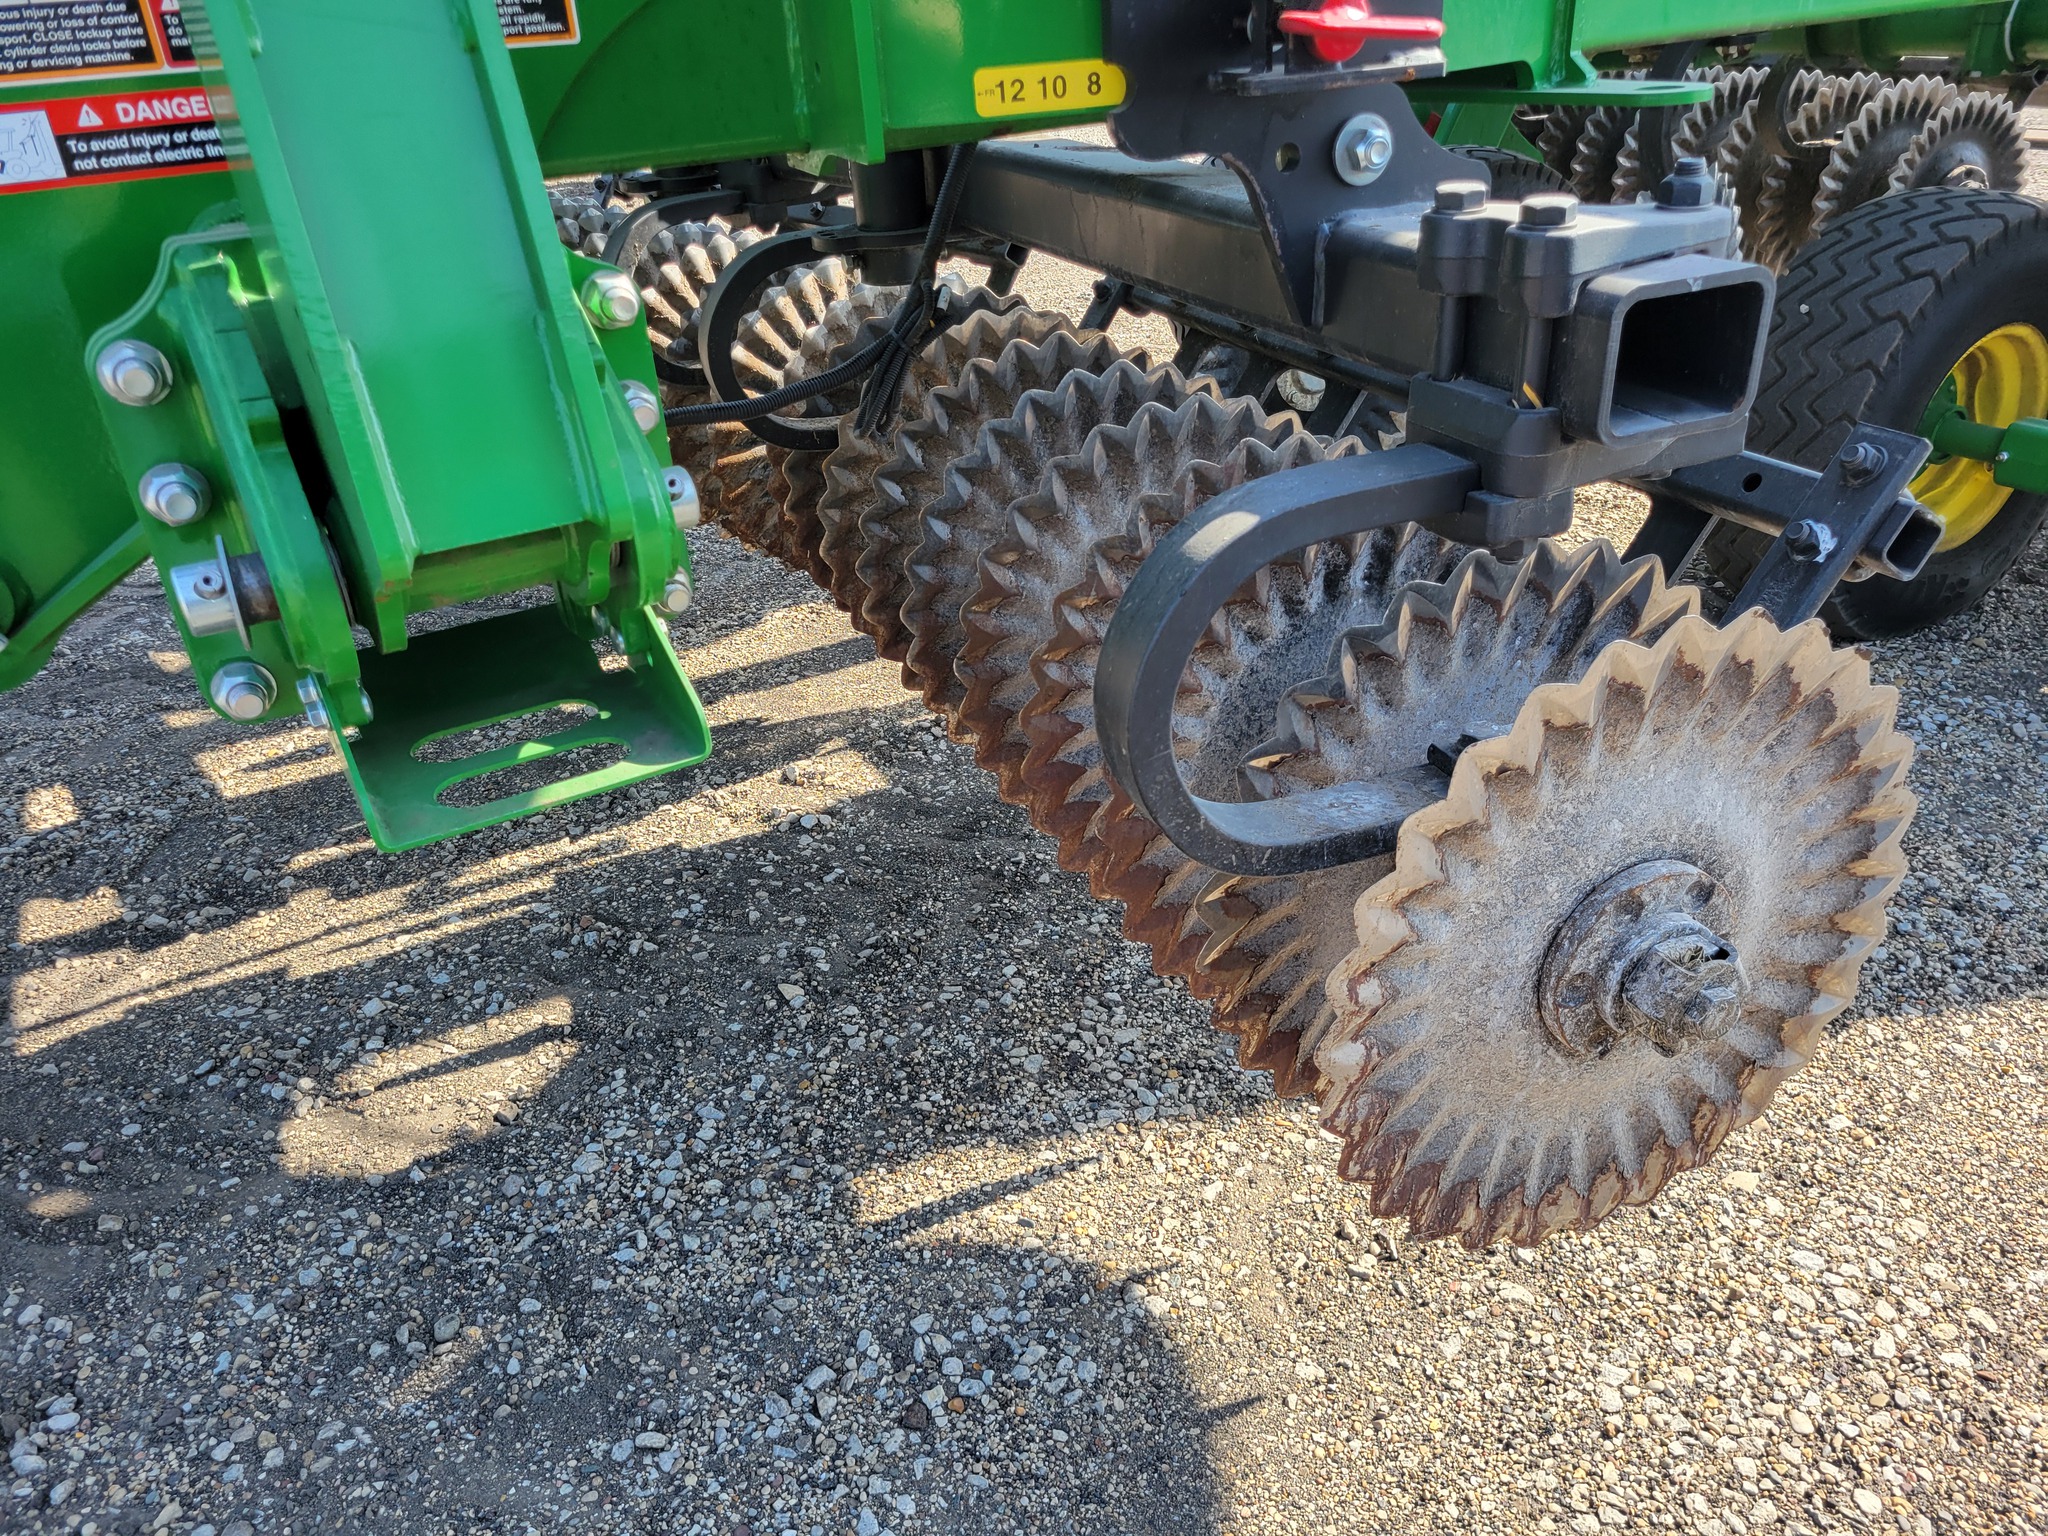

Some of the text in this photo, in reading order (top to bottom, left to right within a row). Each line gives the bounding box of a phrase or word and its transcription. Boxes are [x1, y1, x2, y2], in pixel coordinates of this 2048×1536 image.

[22, 7, 55, 20] injury
[57, 6, 70, 15] or
[72, 3, 103, 15] death
[105, 2, 127, 12] due
[163, 14, 179, 25] To
[513, 12, 546, 26] rapidly
[0, 12, 139, 32] owering or loss of control
[168, 25, 183, 36] do
[524, 21, 566, 36] position.
[32, 29, 74, 43] CLOSE
[75, 28, 113, 40] lockup
[114, 25, 144, 37] valve
[3, 37, 147, 60] cylinder clevis locks before
[16, 59, 28, 69] or
[31, 55, 83, 67] servicing
[84, 51, 134, 63] machine.
[995, 78, 1026, 104] 12
[1037, 75, 1067, 100] 10
[1087, 71, 1102, 96] 8
[66, 139, 88, 154] To
[89, 132, 130, 152] avoid
[130, 131, 171, 150] injury
[172, 130, 189, 144] or
[73, 143, 226, 172] not contact electric lin
